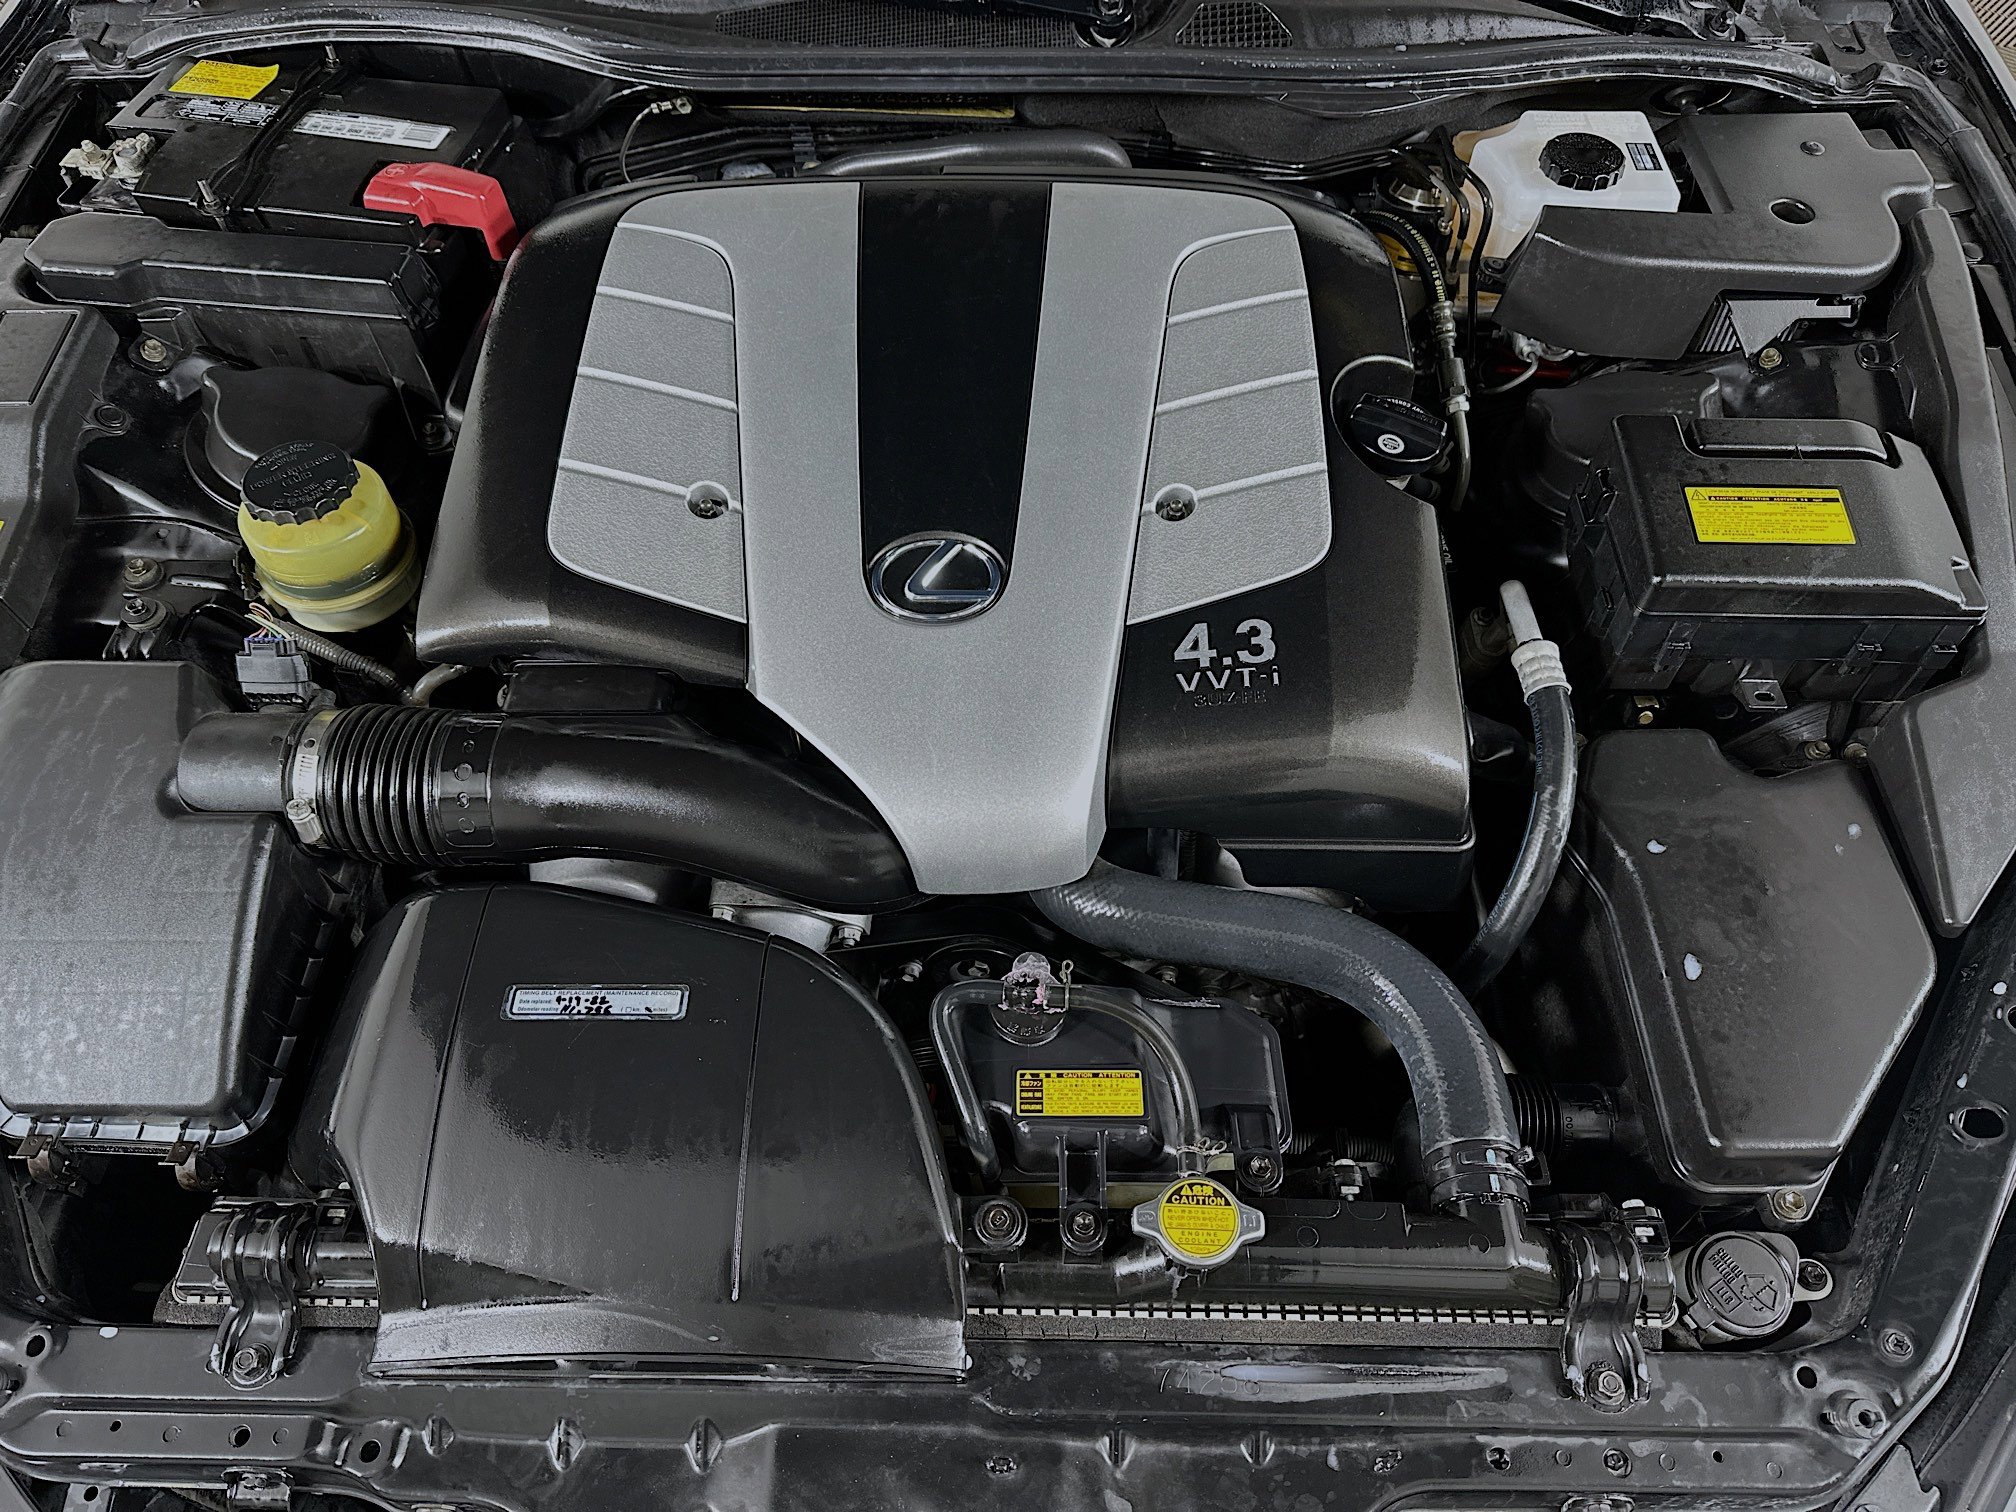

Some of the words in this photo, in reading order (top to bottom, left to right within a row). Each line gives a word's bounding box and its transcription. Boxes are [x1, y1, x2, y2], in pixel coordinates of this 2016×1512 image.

[1174, 619, 1276, 668] 4.3
[1176, 666, 1279, 693] VVT-i
[1172, 1195, 1225, 1206] CAUTION
[1181, 1230, 1218, 1238] ENGINE
